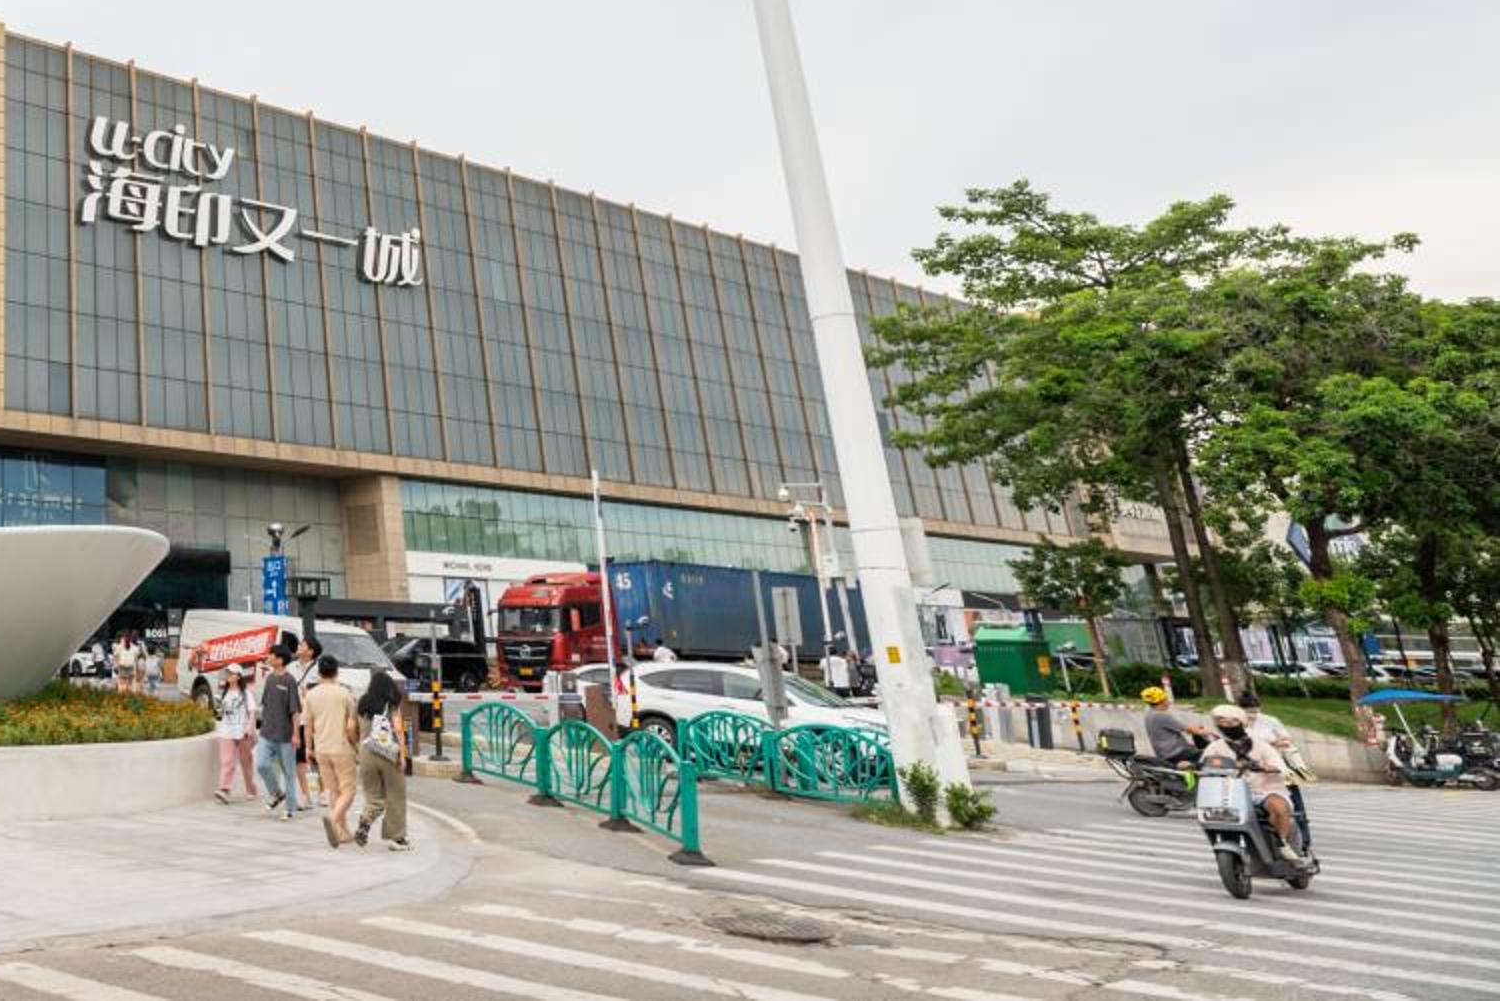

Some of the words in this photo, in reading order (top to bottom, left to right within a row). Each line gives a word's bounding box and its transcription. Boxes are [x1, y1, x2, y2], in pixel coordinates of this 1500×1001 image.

[81, 159, 424, 287] 海印又一城
